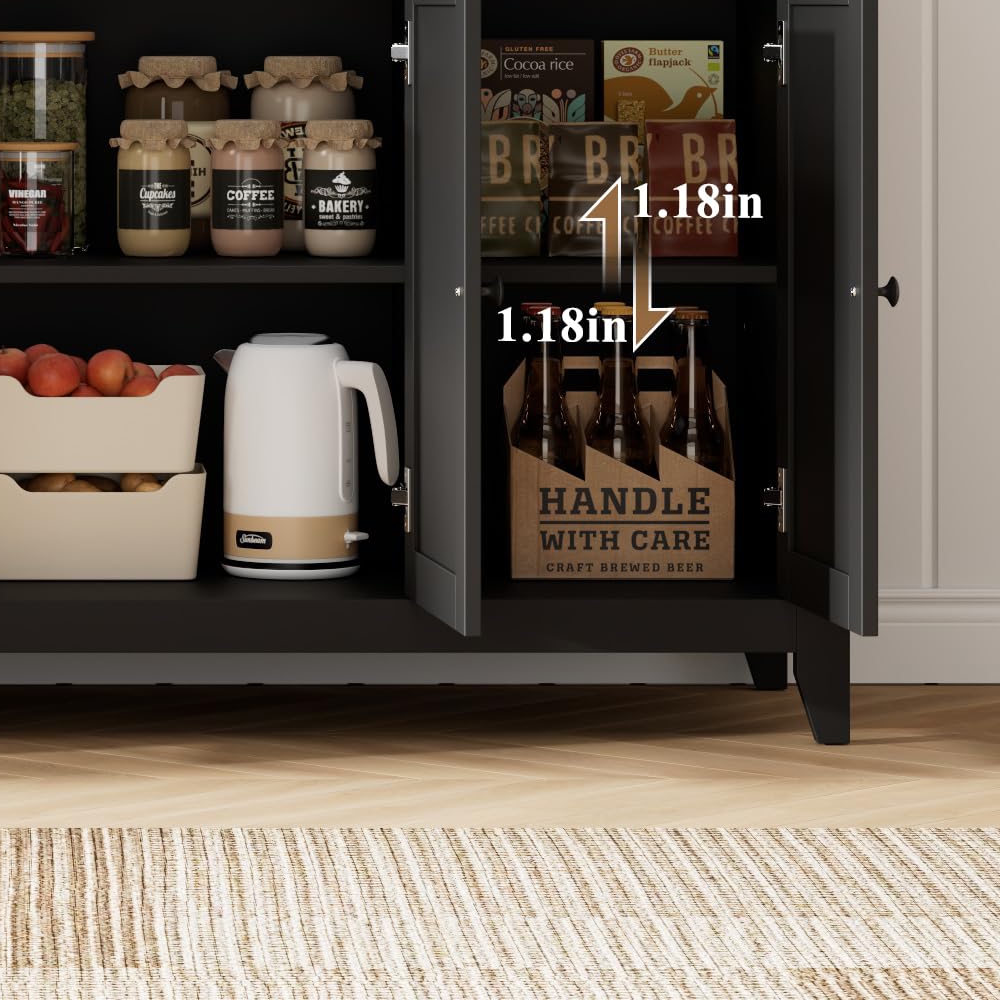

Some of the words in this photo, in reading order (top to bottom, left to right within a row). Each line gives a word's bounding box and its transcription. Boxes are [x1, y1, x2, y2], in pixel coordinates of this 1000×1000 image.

[648, 48, 683, 56] Butter
[503, 57, 546, 71] Cocoa
[549, 57, 575, 71] rice
[648, 58, 692, 68] flapjack
[8, 189, 47, 198] VINEGAR
[139, 187, 176, 202] Cupcakes
[226, 189, 275, 201] COFFEE
[318, 199, 364, 213] BAKERY
[539, 487, 710, 515] HANDLE
[239, 533, 267, 544] Sunbeam
[540, 530, 620, 550] WITH
[631, 530, 710, 550] CARE
[546, 562, 594, 572] CRAFT
[601, 562, 661, 572] BREWED
[667, 562, 704, 572] BEER
